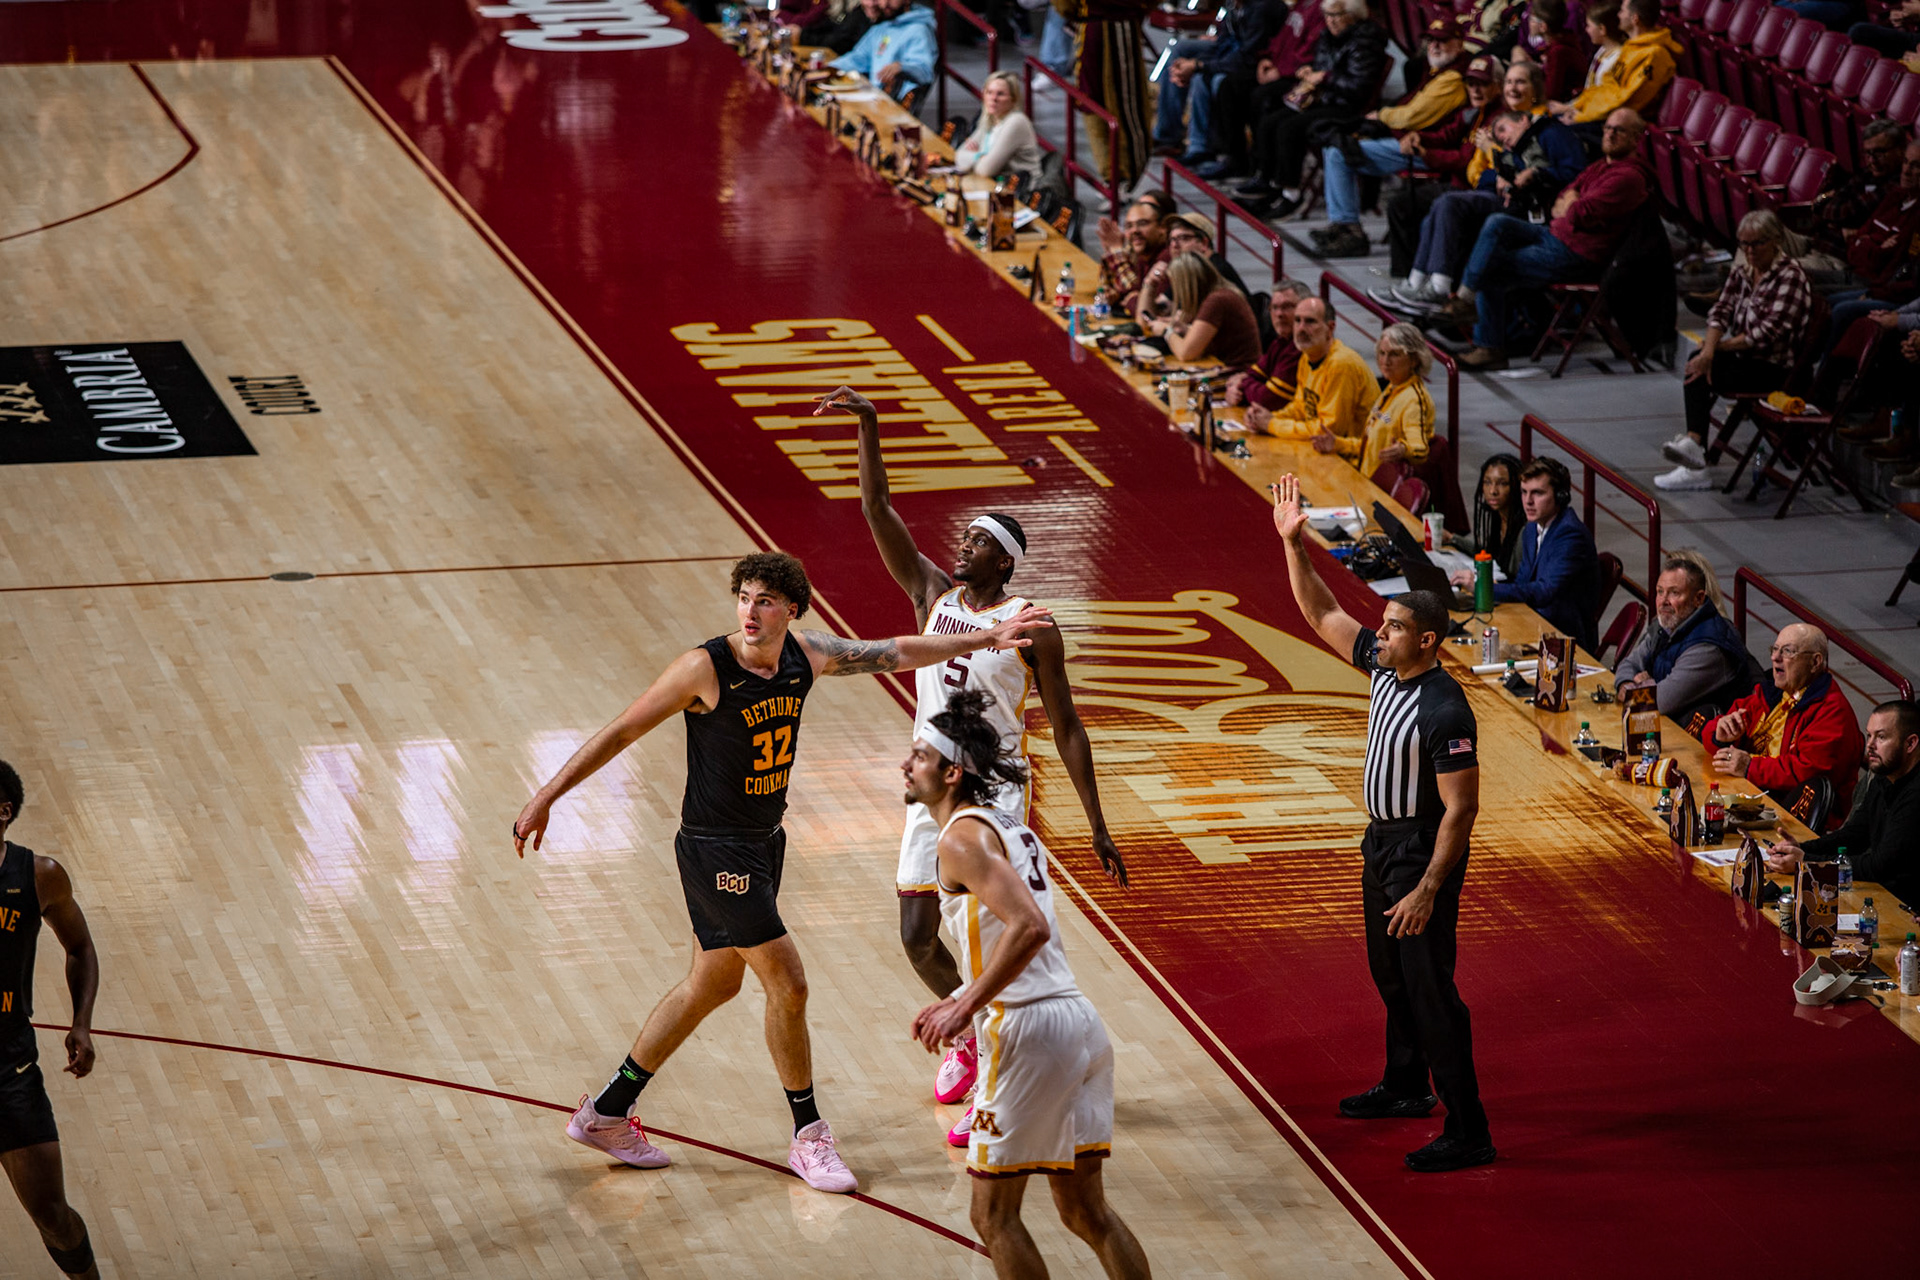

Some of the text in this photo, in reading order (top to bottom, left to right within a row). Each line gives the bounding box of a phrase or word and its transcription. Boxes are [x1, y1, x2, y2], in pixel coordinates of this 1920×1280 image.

[59, 348, 185, 453] CAMBRIA
[228, 376, 321, 415] COURT
[670, 318, 1035, 499] WILLIAMS
[942, 361, 1099, 431] ARENA
[933, 613, 1000, 655] MINNE
[944, 652, 973, 689] 5
[741, 696, 801, 728] BETHUNE
[752, 724, 793, 771] 32
[745, 768, 791, 795] COOKMA
[1122, 766, 1371, 865] THE
[1020, 832, 1047, 891] 3
[716, 871, 750, 894] BCU
[1, 991, 13, 1012] N
[971, 1108, 1003, 1137] M
